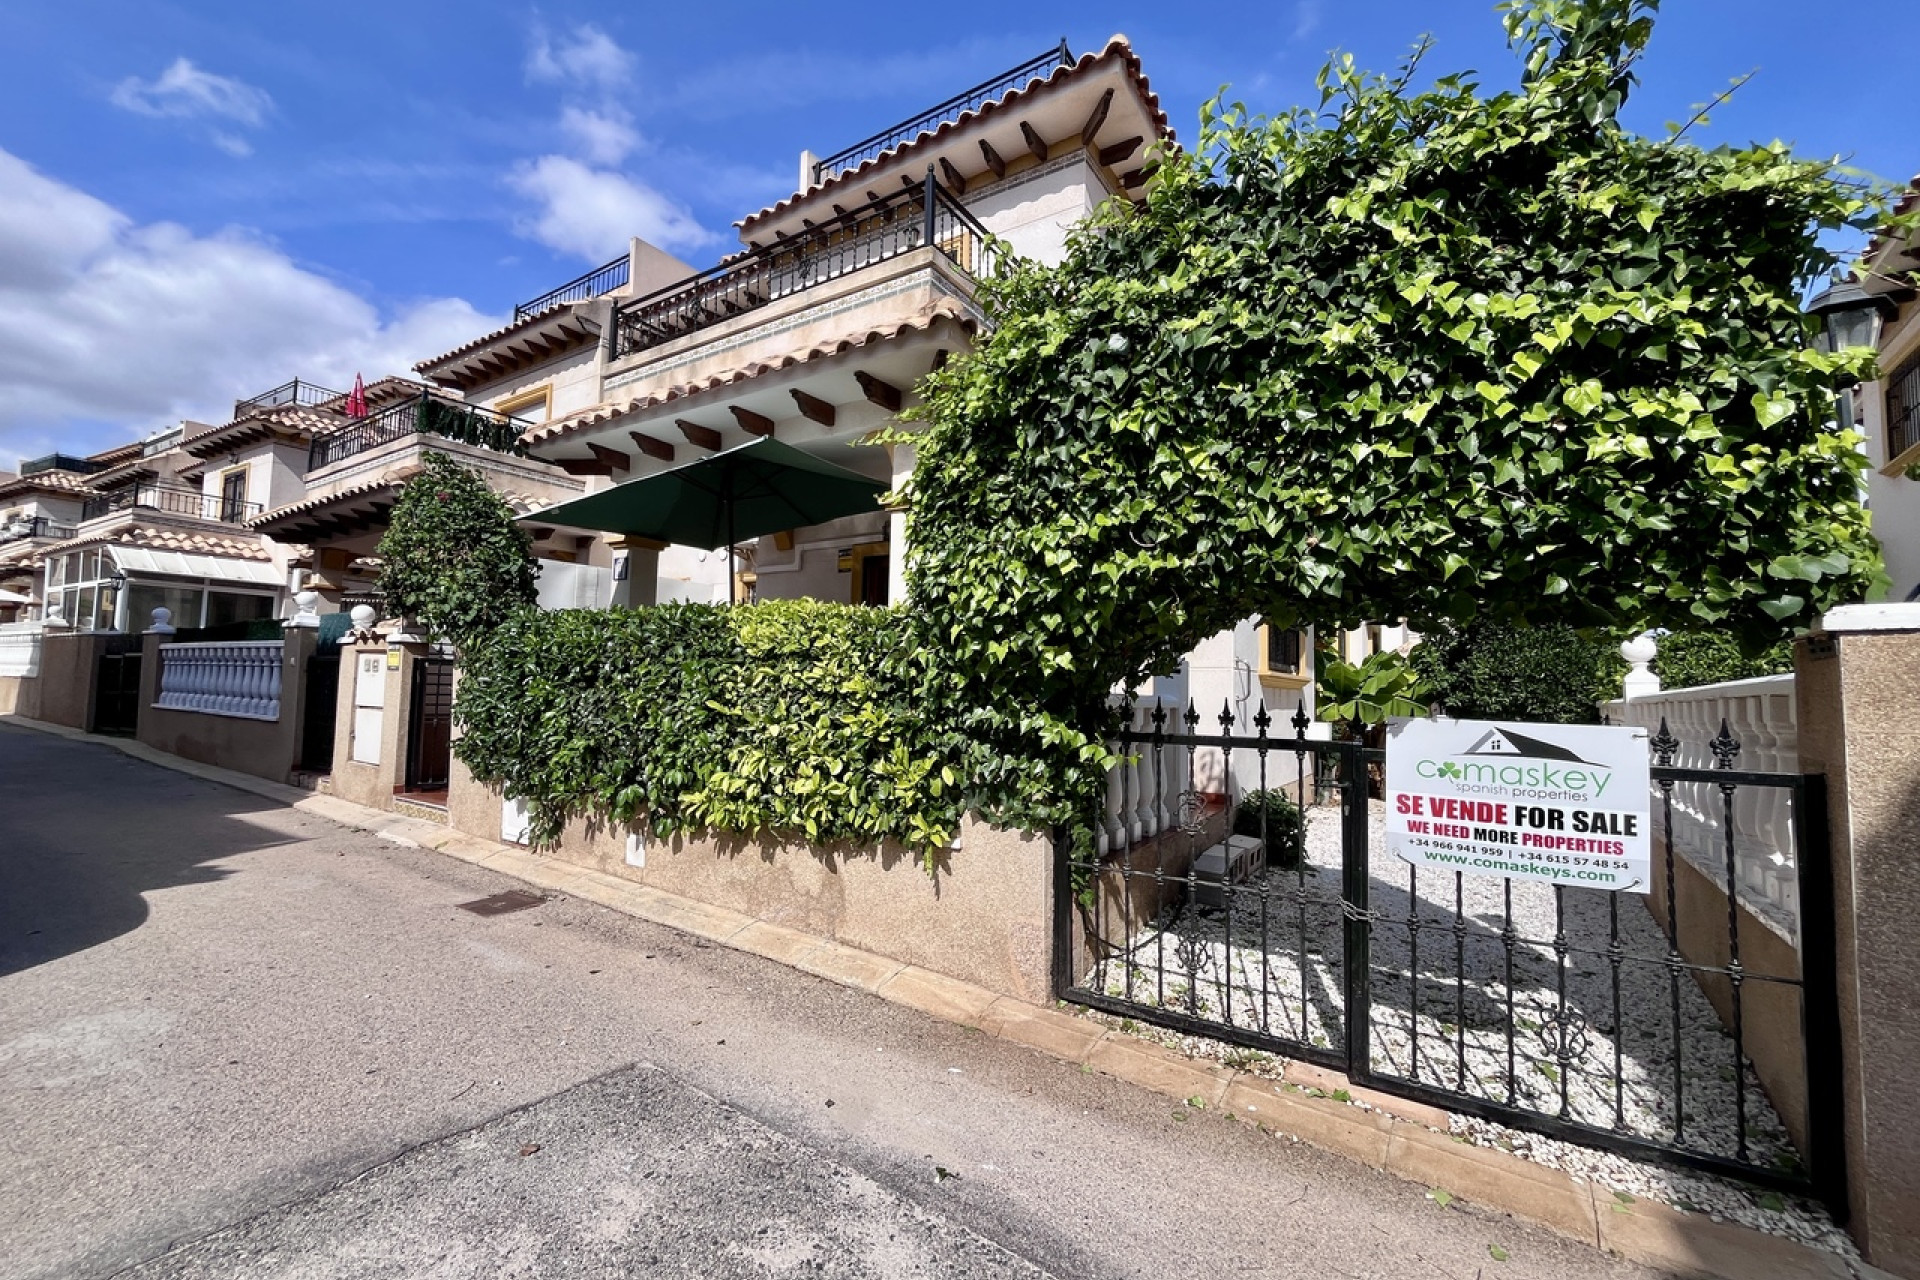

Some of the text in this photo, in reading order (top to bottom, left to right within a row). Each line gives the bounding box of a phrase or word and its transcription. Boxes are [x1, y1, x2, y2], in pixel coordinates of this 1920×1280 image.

[1456, 783, 1588, 802] spanish properties
[1396, 793, 1638, 837] SE VENDE FOR SALE
[1407, 820, 1624, 855] WE NEED MORE PROPERTIES
[1409, 838, 1429, 847] +34
[1432, 840, 1453, 851] 966
[1456, 843, 1477, 854] 941
[1481, 846, 1503, 857] 959
[1518, 852, 1542, 862] +34
[1546, 853, 1569, 864] 615
[1573, 857, 1589, 866] 57
[1593, 859, 1609, 869] 48
[1613, 861, 1629, 870] 54
[1424, 850, 1616, 882] www.comaskeys.com
